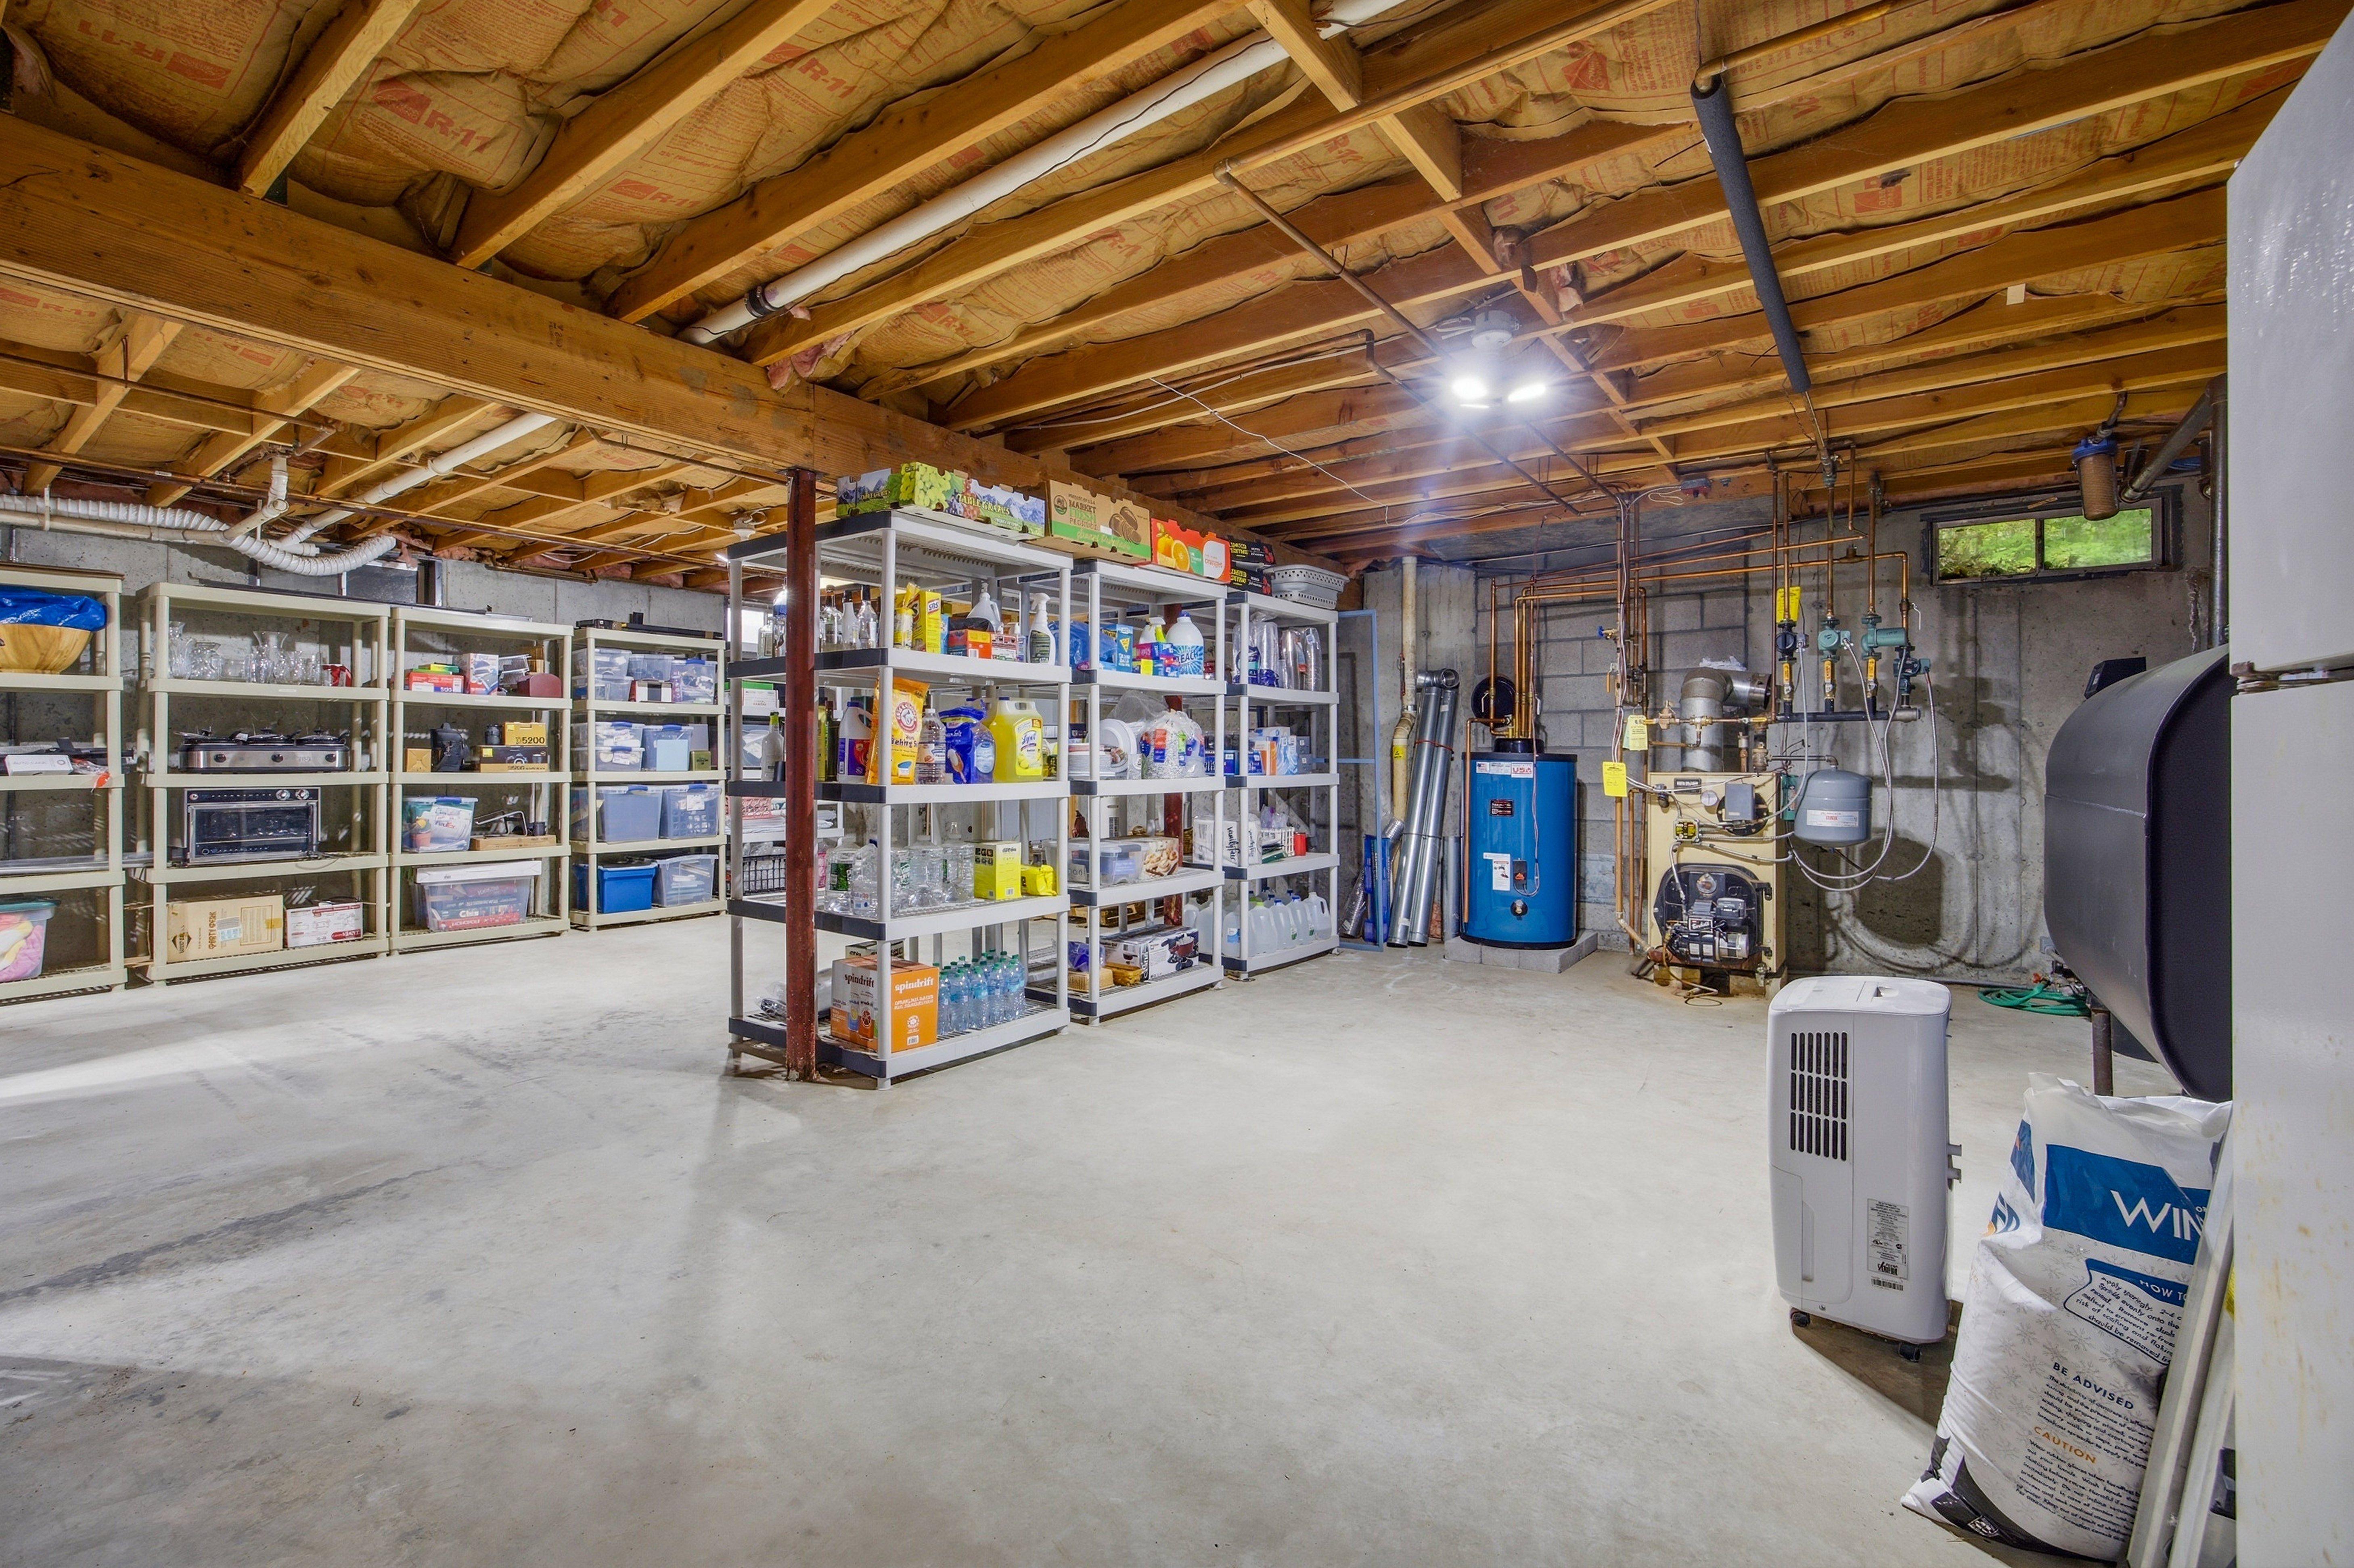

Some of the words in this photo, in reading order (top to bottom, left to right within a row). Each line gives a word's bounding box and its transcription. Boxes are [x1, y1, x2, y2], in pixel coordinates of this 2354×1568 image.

[798, 57, 857, 99] R-11
[424, 109, 492, 154] R-11
[1069, 500, 1097, 513] MARKET
[208, 911, 217, 928] PERK
[208, 929, 217, 950] PARTY
[844, 973, 875, 988] spindrift
[895, 977, 934, 994] spindrift
[2140, 1280, 2173, 1298] HOW
[2076, 1299, 2088, 1308] risk
[2132, 1331, 2148, 1340] and
[2122, 1300, 2145, 1316] evenly
[2147, 1315, 2164, 1324] onto
[2168, 1321, 2179, 1329] the
[2089, 1316, 2113, 1330] should
[2115, 1328, 2124, 1336] be
[2053, 1362, 2068, 1376] BE
[2073, 1375, 2134, 1410] ADVISED
[2034, 1426, 2097, 1464] CAUTION
